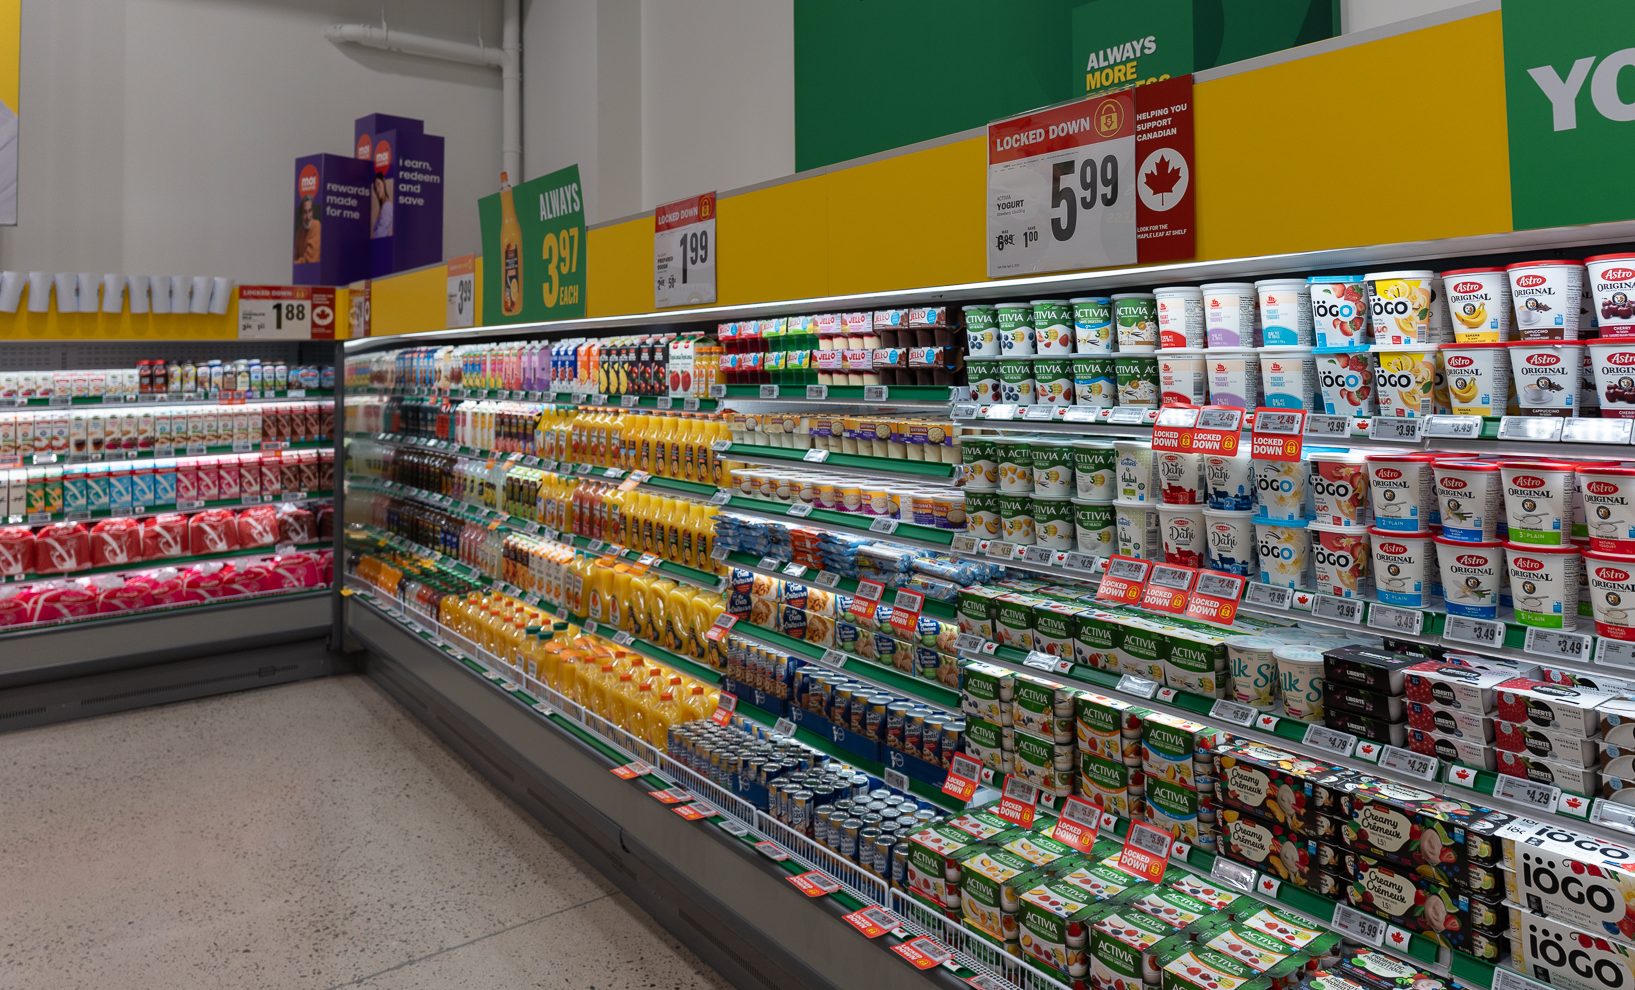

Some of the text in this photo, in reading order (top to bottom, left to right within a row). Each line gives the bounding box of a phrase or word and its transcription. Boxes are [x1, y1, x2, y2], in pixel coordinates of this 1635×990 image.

[1087, 35, 1157, 71] ALWAYS
[1086, 61, 1137, 91] MORE
[1137, 104, 1187, 120] HELPING YOU
[1137, 118, 1172, 131] SUPPORT
[997, 117, 1090, 152] LOCKED DOWN
[1137, 128, 1177, 142] CANADIAN
[404, 160, 432, 171] earn,
[399, 170, 440, 183] redeem
[327, 183, 370, 196] rewards
[399, 183, 420, 193] and
[326, 195, 357, 206] made
[399, 196, 424, 206] save
[540, 183, 580, 221] ALWAYS
[997, 200, 1024, 210] YOGURT
[326, 207, 360, 219] for me
[658, 207, 698, 225] LOCKED DOWN
[1137, 224, 1147, 233] LOOK
[1606, 269, 1632, 279] Astro
[1456, 283, 1479, 292] Astro
[1519, 277, 1542, 286] Astro
[560, 286, 578, 305] EACH
[1451, 293, 1491, 303] ORIGINAL
[1514, 288, 1555, 297] ORIGINAL
[1450, 357, 1469, 366] Astro
[1531, 354, 1554, 364] Astro
[1522, 367, 1568, 375] ORIGINAL
[1278, 415, 1295, 425] $2.49
[1328, 422, 1345, 432] $3.99
[1154, 438, 1178, 447] DOWN
[1194, 433, 1221, 441] LOCKED
[1254, 438, 1283, 446] LOCKED
[1193, 440, 1220, 450] DOWN
[1254, 445, 1282, 455] DOWN
[1162, 462, 1185, 477] Dahi
[1208, 466, 1230, 481] Dahi
[1377, 469, 1398, 479] Astro
[1373, 480, 1410, 488] ORIGINAL
[1443, 478, 1465, 488] Astro
[1515, 476, 1540, 487] Astro
[1589, 483, 1614, 493] Astro
[1438, 489, 1475, 499] ORIGINAL
[1509, 488, 1553, 498] ORIGINAL
[1584, 494, 1628, 505] ORIGINAL
[1170, 526, 1195, 542] Dahi
[1212, 532, 1237, 548] Dahi
[1381, 543, 1403, 553] Astro
[1376, 553, 1414, 564] ORIGINAL
[1458, 556, 1485, 566] Astro
[1516, 559, 1539, 569] Astro
[1171, 571, 1186, 580] $2.49
[1451, 565, 1494, 575] ORIGINAL
[1511, 569, 1552, 581] ORIGINAL
[1599, 568, 1625, 579] Astro
[1102, 580, 1127, 589] LOCKED
[1219, 579, 1234, 589] $2.49
[1100, 586, 1126, 598] DOWN
[1147, 589, 1172, 599] LOCKED
[1269, 593, 1285, 603] $3.99
[963, 600, 986, 612] ACTIVIA
[1145, 597, 1170, 607] DOWN
[1192, 597, 1219, 608] LOCKED
[1001, 608, 1026, 621] ACTIVIA
[1189, 605, 1217, 617] DOWN
[1337, 604, 1355, 617] $3.99
[1038, 617, 1065, 631] ACTIVIA
[1081, 626, 1111, 640] ACTIVIA
[1474, 627, 1495, 640] $3.49
[1124, 635, 1156, 650] ACTIVIA
[1558, 640, 1581, 654] $3.49
[1171, 646, 1207, 662] ACTIVIA
[968, 678, 993, 692] ACTIVIA
[1019, 688, 1048, 703] ACTIVIA
[1083, 707, 1113, 723] ACTIVIA
[971, 726, 995, 739] ACTIVIA
[1150, 728, 1184, 747] ACTIVIA
[1020, 741, 1048, 758] ACTIVIA
[1329, 737, 1347, 749] $4.79
[1089, 763, 1120, 781] ACTIVIA
[1408, 759, 1428, 773] $4.29
[1232, 767, 1260, 786] Creamy
[945, 783, 963, 794] DOWN
[1154, 788, 1189, 807] ACTIVIA
[1527, 789, 1549, 804] $4.29
[1002, 800, 1023, 812] LOCKED
[1000, 807, 1020, 820] DOWN
[1363, 808, 1398, 828] Creamy
[1058, 821, 1081, 834] LOCKED
[1234, 822, 1263, 841] Creamy
[1362, 820, 1402, 839] Crémeux
[1055, 829, 1078, 843] DOWN
[1035, 837, 1064, 852] ACTIVIA
[913, 850, 938, 870] ACTIVIA
[1124, 848, 1150, 863] LOCKED
[1122, 856, 1147, 872] DOWN
[1095, 865, 1128, 884] ACTIVIA
[1368, 870, 1403, 892] Creamy
[966, 876, 994, 898] ACTIVIA
[1056, 883, 1088, 901] ACTIVIA
[1366, 880, 1406, 904] Crémeux
[1167, 892, 1204, 911] ACTIVIA
[1026, 911, 1057, 934] ACTIVIA
[1129, 912, 1166, 931] ACTIVIA
[1359, 922, 1378, 938] $5.99
[1238, 930, 1286, 951] ACTIVIA
[1098, 939, 1134, 964] ACTIVIA
[1202, 950, 1244, 974] ACTIVIA
